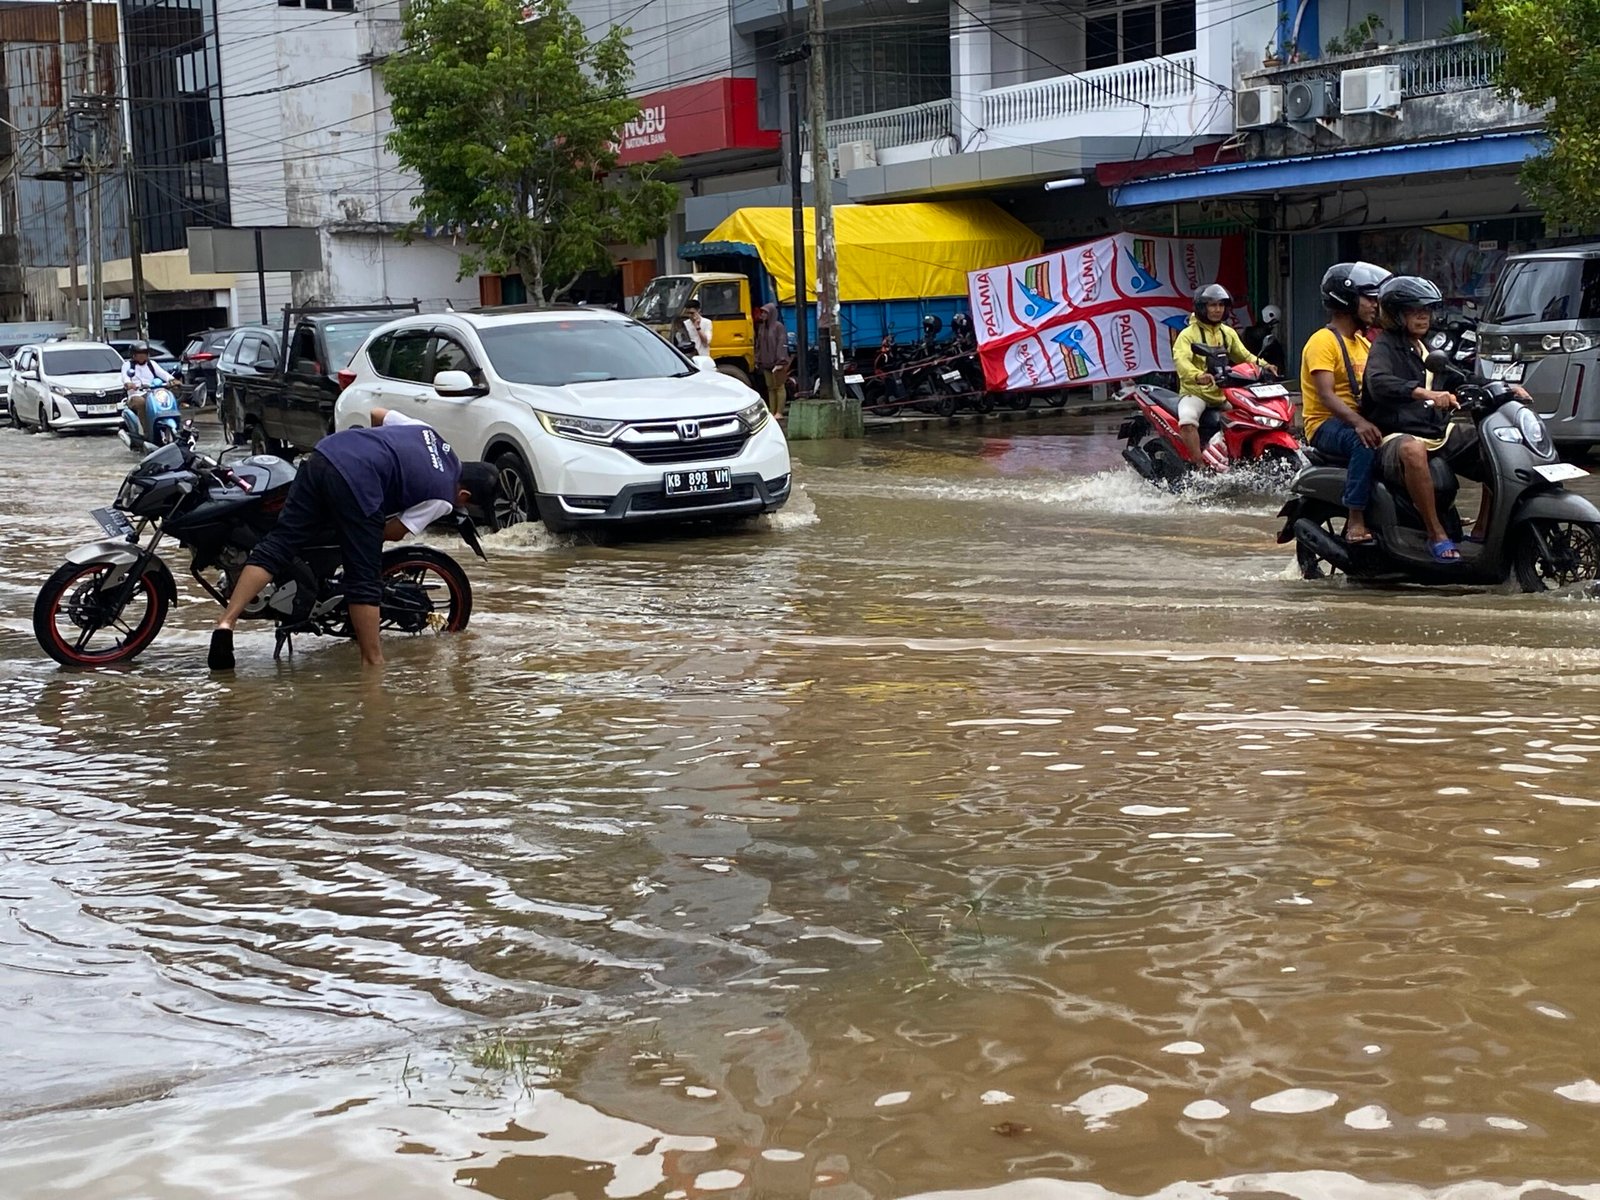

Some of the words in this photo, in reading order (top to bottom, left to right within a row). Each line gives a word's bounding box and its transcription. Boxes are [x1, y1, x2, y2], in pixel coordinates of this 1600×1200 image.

[624, 105, 666, 138] NOBU
[625, 134, 650, 149] NATIONAL
[650, 132, 666, 146] BANK
[1082, 248, 1094, 302] PALMIA
[1186, 243, 1199, 291] PALMIA
[977, 272, 998, 337] PALMIA
[1119, 314, 1137, 372] PALMIA
[667, 474, 681, 487] KB
[688, 472, 708, 486] 898
[715, 470, 728, 483] VM
